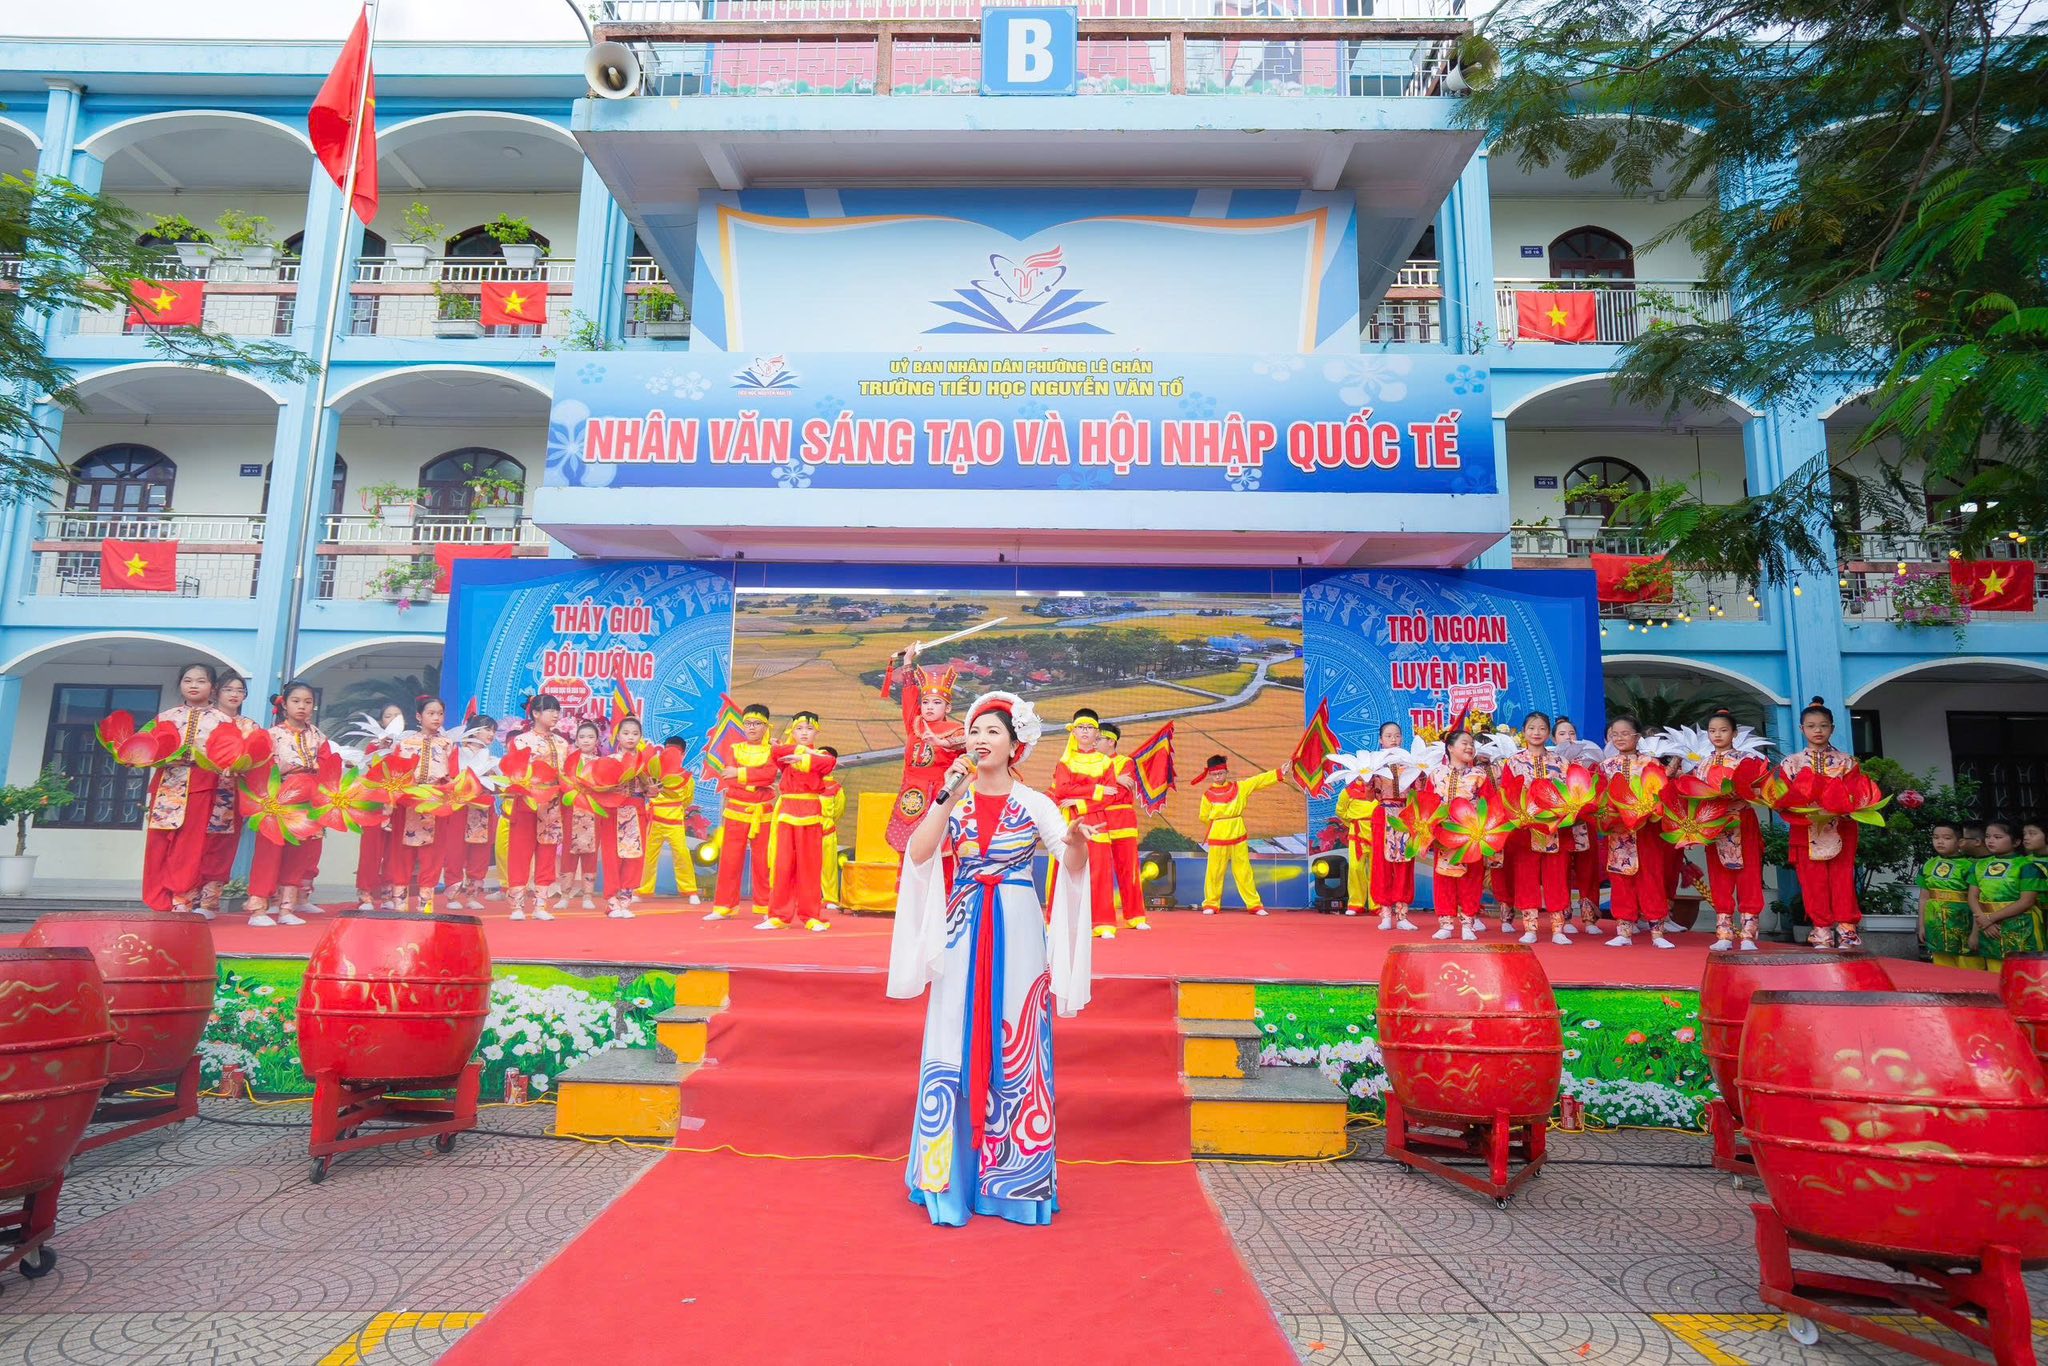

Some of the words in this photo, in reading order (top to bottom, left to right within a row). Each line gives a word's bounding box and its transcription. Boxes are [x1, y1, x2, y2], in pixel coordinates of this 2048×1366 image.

[1007, 18, 1054, 83] B
[890, 357, 910, 374] UỶ
[912, 360, 944, 374] BAN
[947, 358, 989, 374] NHÂN
[992, 358, 1024, 374] DÂN
[1026, 358, 1087, 374] PHƯỜNG
[1090, 359, 1108, 374] LÊ
[1111, 358, 1153, 374] CHÂN
[858, 377, 935, 396] TRƯỜNG
[939, 375, 982, 396] TIỂU
[986, 380, 1026, 399] HỌC
[1031, 376, 1110, 396] NGUYỄN
[1114, 377, 1155, 396] VĂN
[1158, 376, 1185, 397] TỐ
[584, 410, 700, 464] NHÂN
[709, 410, 791, 464] VĂN
[802, 410, 914, 465] SÁNG
[924, 418, 1005, 475] TẠO
[1014, 411, 1071, 466] VÀ
[1080, 411, 1151, 476] HỘI
[1161, 411, 1278, 476] NHẬP
[1287, 408, 1401, 473] QUỐC
[1408, 409, 1462, 469] TẾ
[553, 597, 605, 633] THẦY
[610, 598, 651, 634] GIỎI
[1387, 608, 1428, 643] TRÒ
[1433, 615, 1507, 643] NGOAN
[543, 642, 578, 677] BỒI
[584, 645, 654, 680] DƯỠNG
[1391, 656, 1459, 695] LUYỆN
[1464, 656, 1508, 690] RÈN
